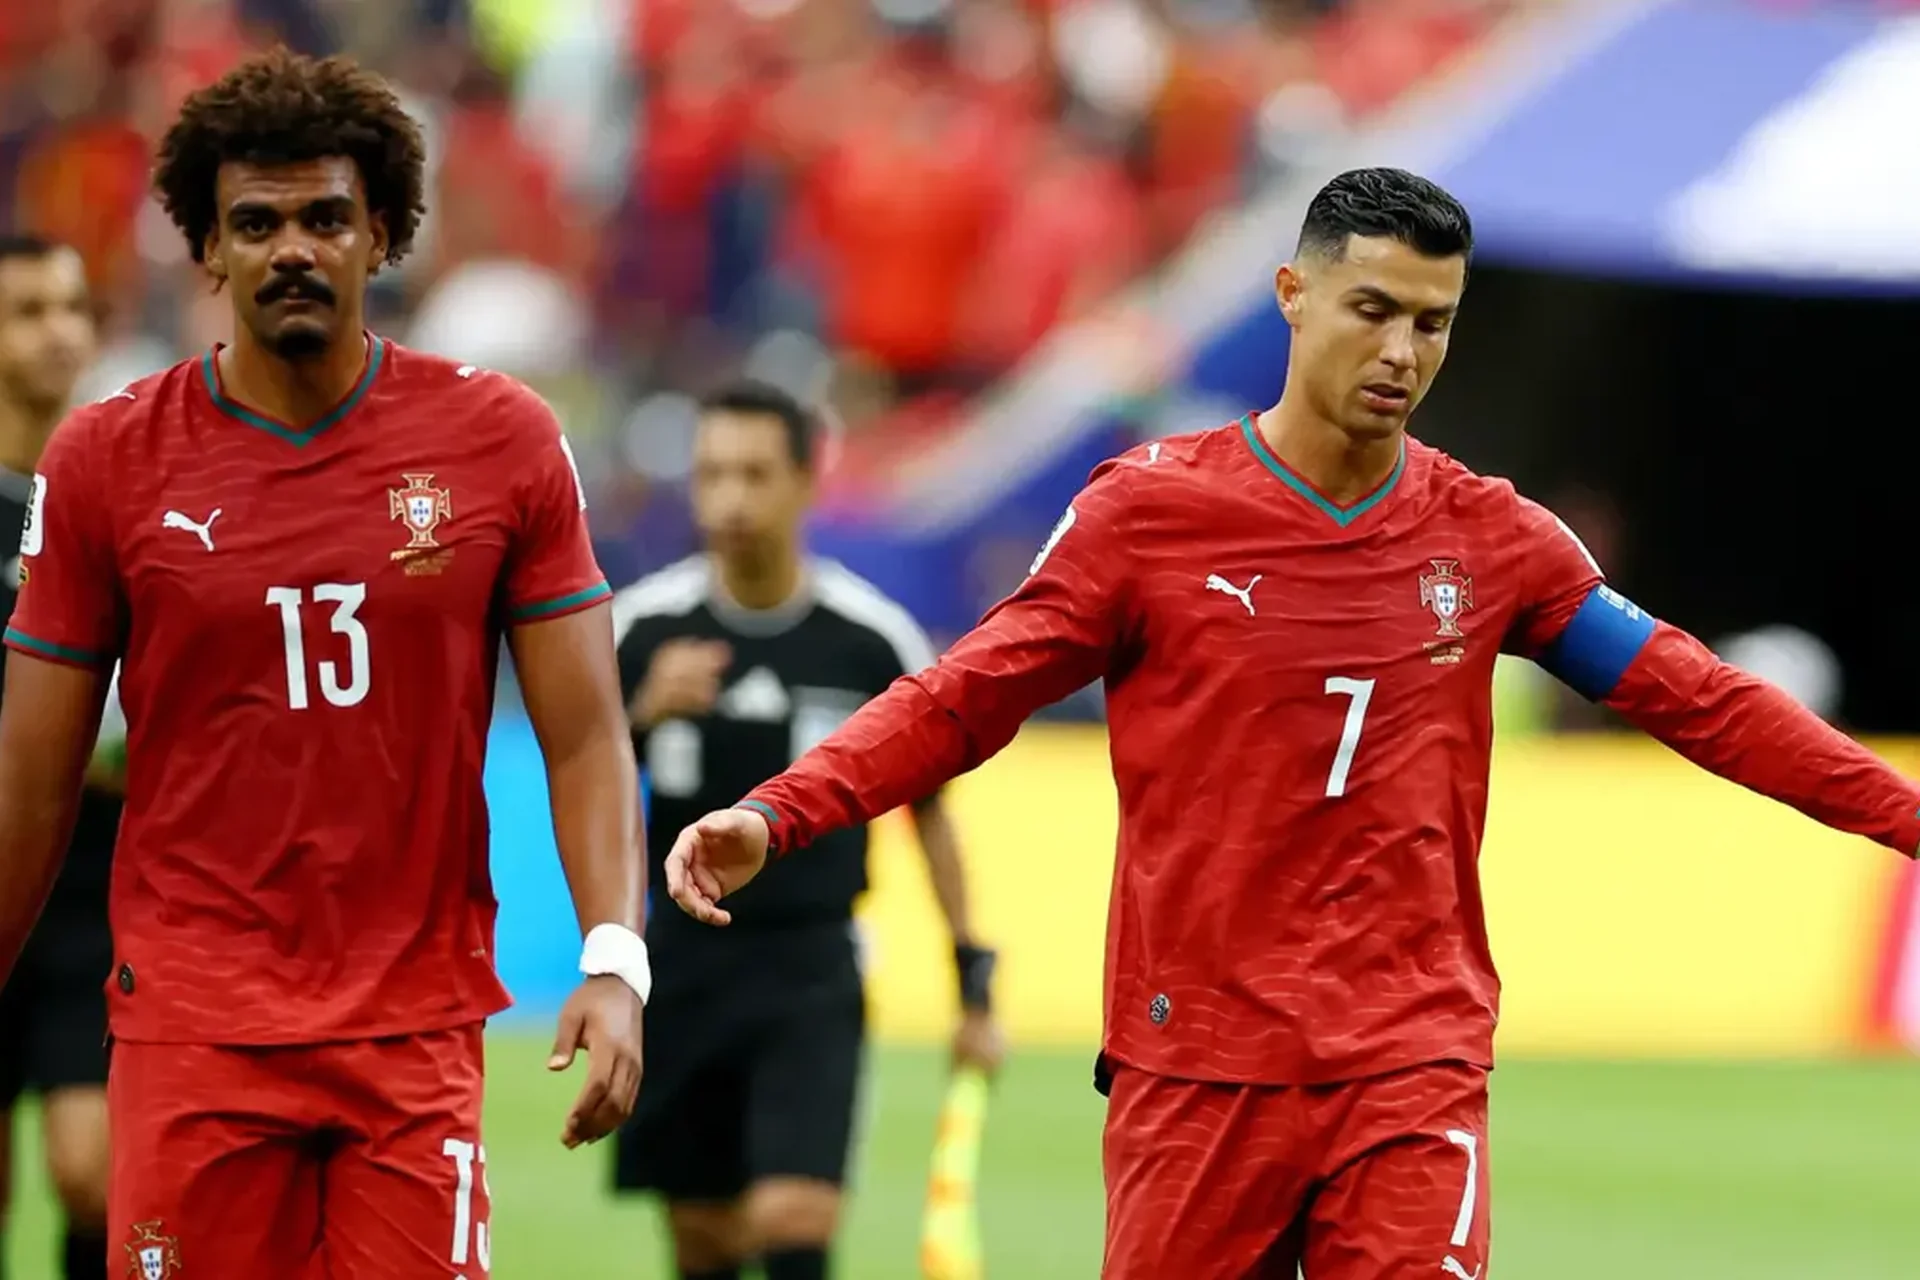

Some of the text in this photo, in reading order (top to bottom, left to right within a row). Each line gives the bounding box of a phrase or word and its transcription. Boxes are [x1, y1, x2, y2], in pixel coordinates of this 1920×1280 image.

[265, 582, 371, 710] 13
[1325, 676, 1377, 797] 7
[1445, 1129, 1477, 1247] 7
